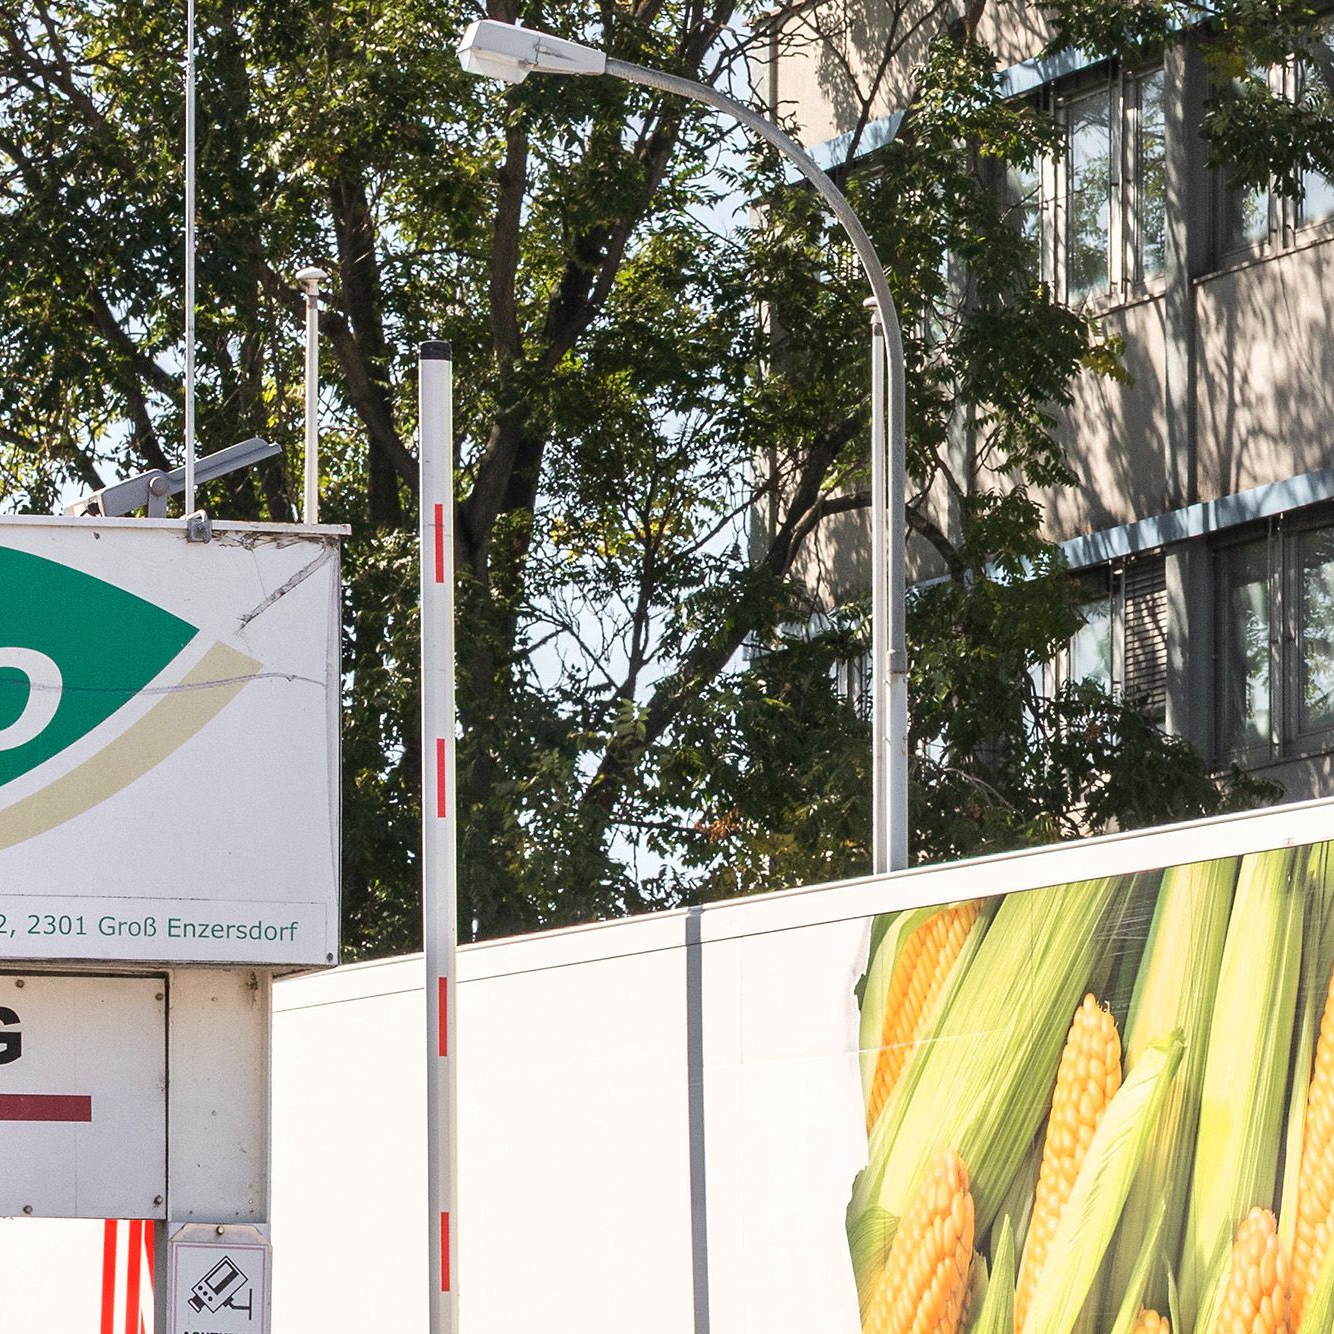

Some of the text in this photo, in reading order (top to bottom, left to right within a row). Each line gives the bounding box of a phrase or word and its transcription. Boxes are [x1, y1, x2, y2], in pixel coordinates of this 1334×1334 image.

[27, 914, 87, 936] 2301
[97, 915, 157, 937] Groß
[167, 918, 299, 942] Enzersdorf
